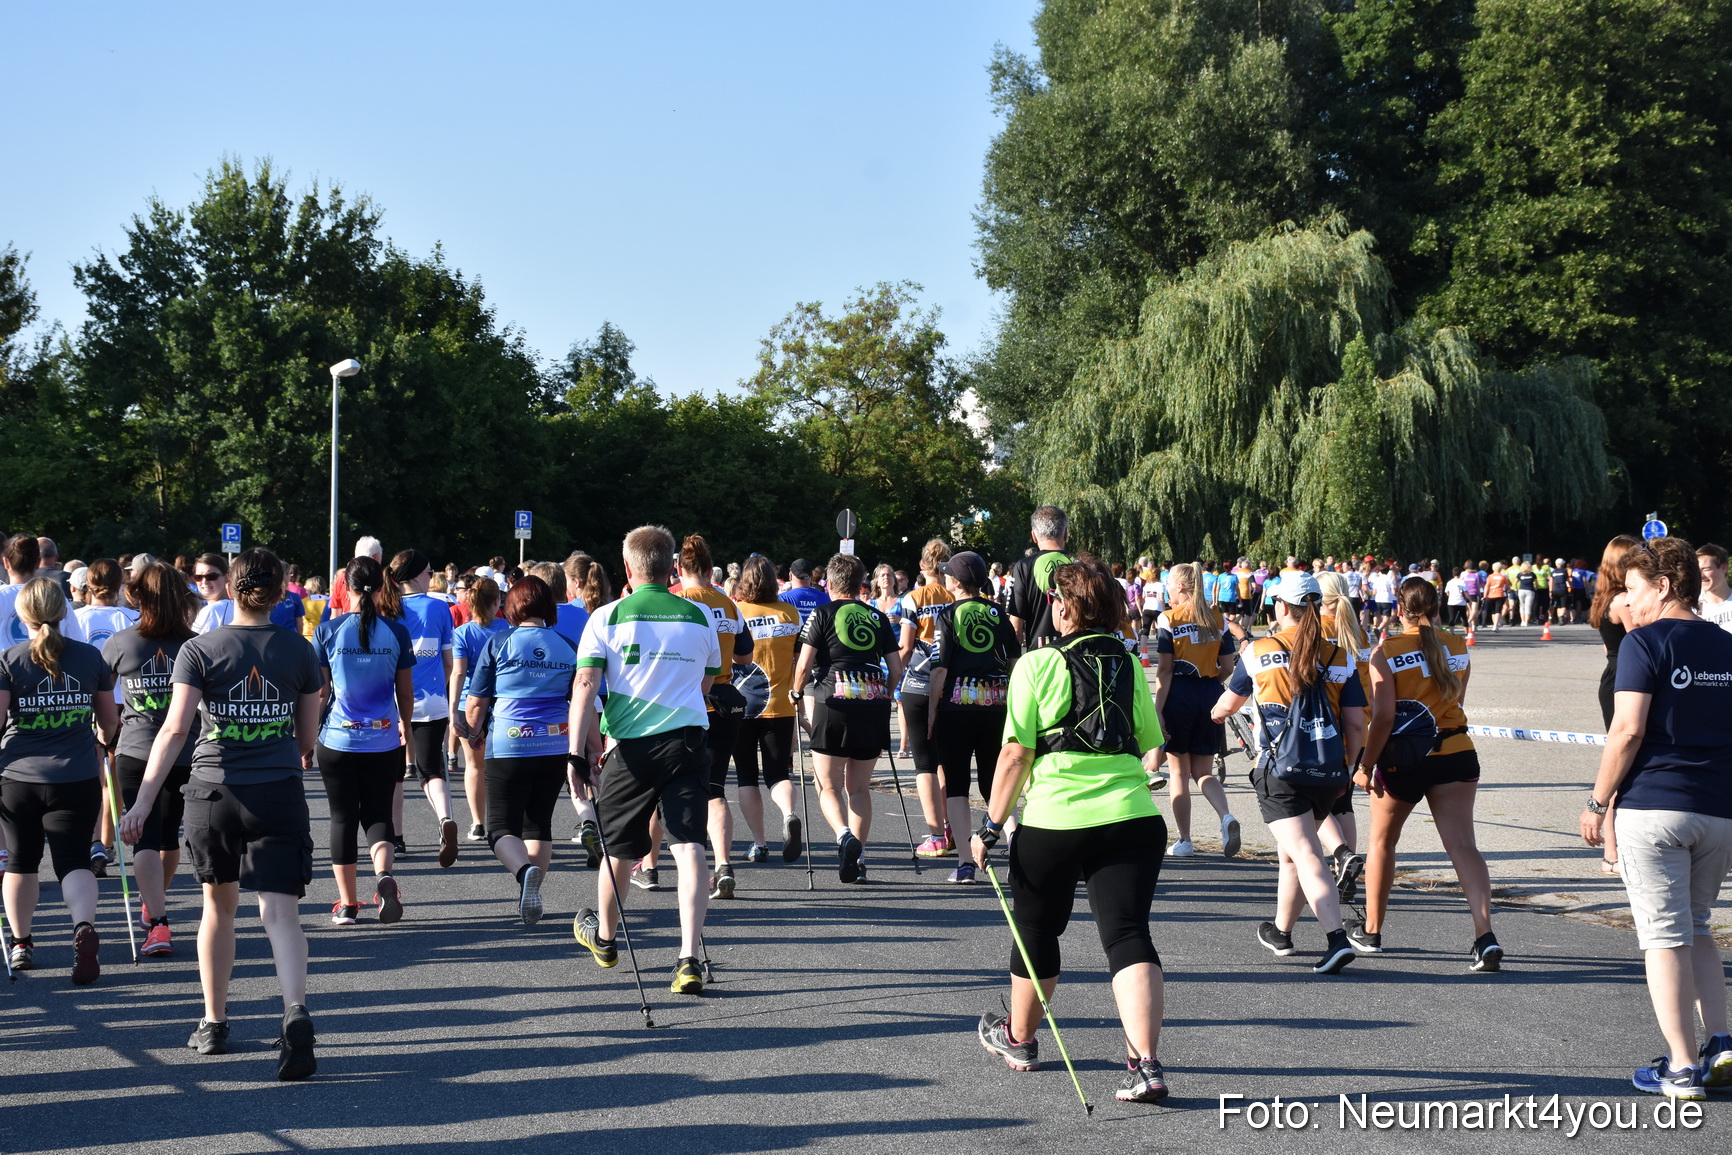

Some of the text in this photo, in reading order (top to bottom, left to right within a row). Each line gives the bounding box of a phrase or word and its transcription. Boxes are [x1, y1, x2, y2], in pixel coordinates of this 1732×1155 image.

[519, 513, 528, 527] P
[226, 526, 237, 540] P
[748, 616, 775, 628] nzin
[1172, 624, 1199, 637] Benz
[1260, 653, 1290, 668] Ben
[1392, 652, 1425, 668] Ben
[18, 693, 93, 708] BURKHARDT
[209, 701, 295, 717] BURKHARDT
